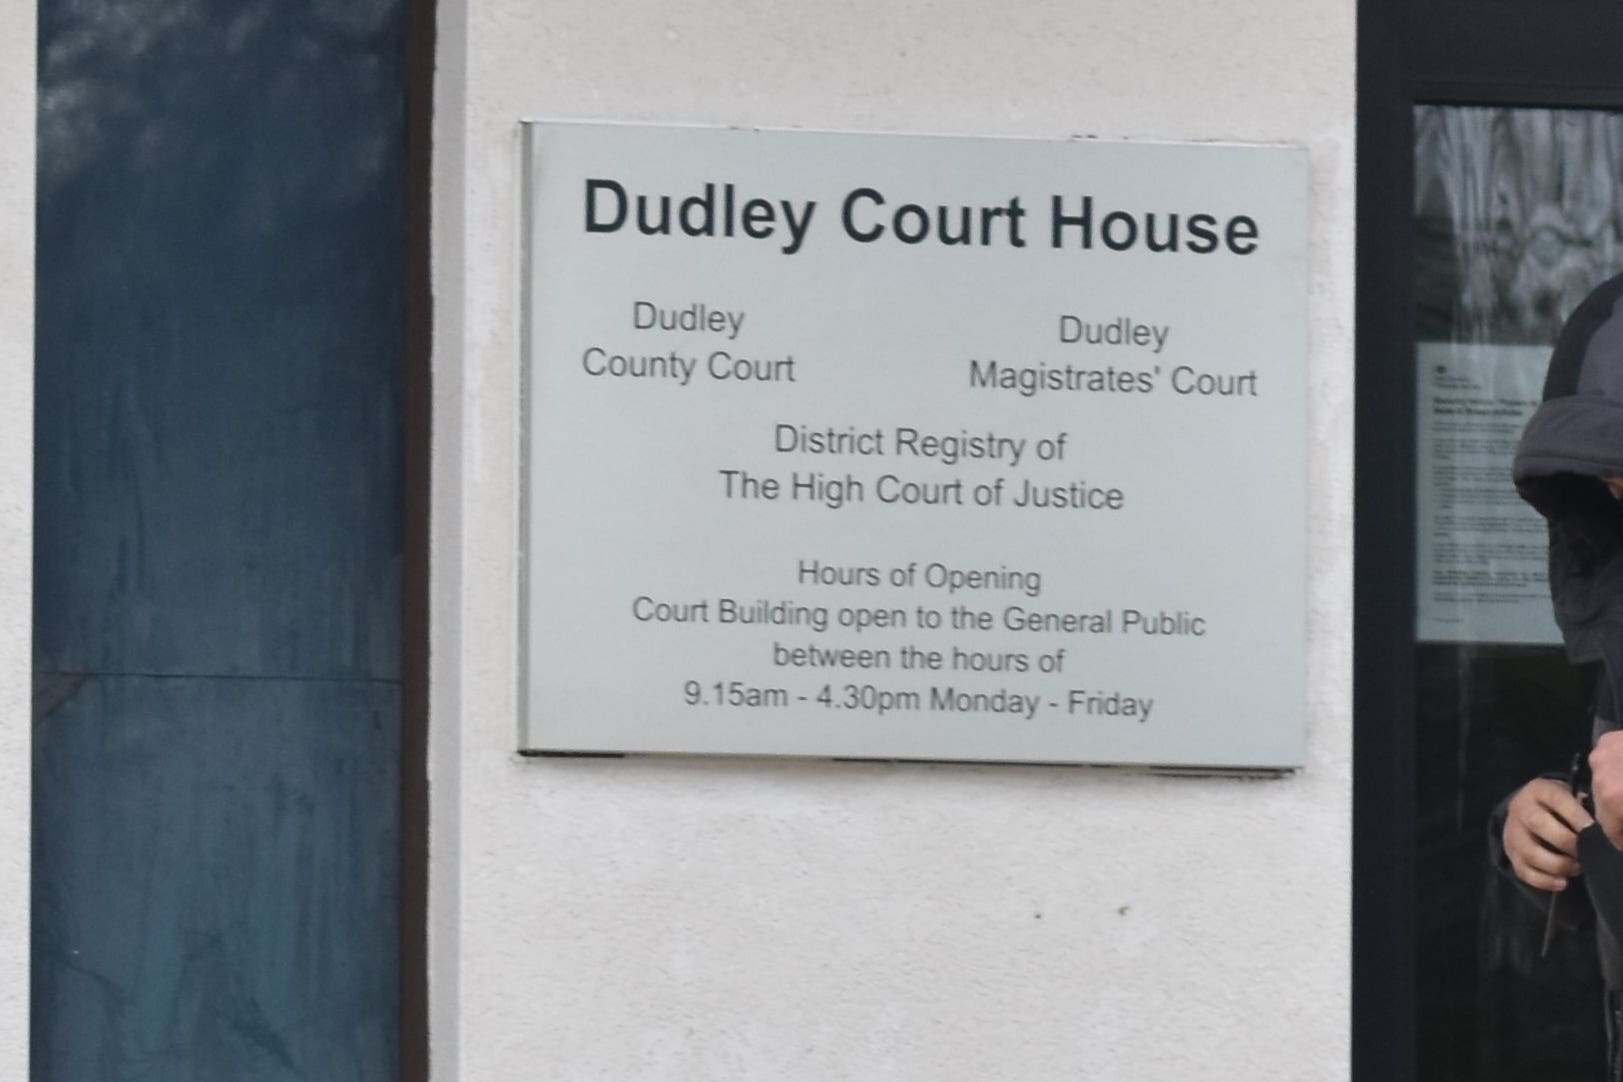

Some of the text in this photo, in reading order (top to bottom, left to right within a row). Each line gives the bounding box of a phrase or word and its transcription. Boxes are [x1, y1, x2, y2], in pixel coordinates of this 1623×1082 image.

[583, 177, 1260, 257] Dudley Court House
[632, 300, 746, 341] Dudley
[1058, 314, 1170, 353] Dudley
[581, 346, 797, 387] County Court
[969, 359, 1259, 398] Magistrates' Court
[774, 423, 1069, 465] District Registry of
[717, 469, 1125, 511] The High Court of Justice
[798, 559, 1042, 598] Hours of Opening
[632, 595, 1206, 637] Court Building open to the General Public
[773, 641, 1067, 674] between the hours of
[683, 679, 789, 708] 9.15am
[815, 683, 921, 716] 4.30pm
[929, 686, 1041, 721] Monday
[1067, 689, 1154, 724] Friday
